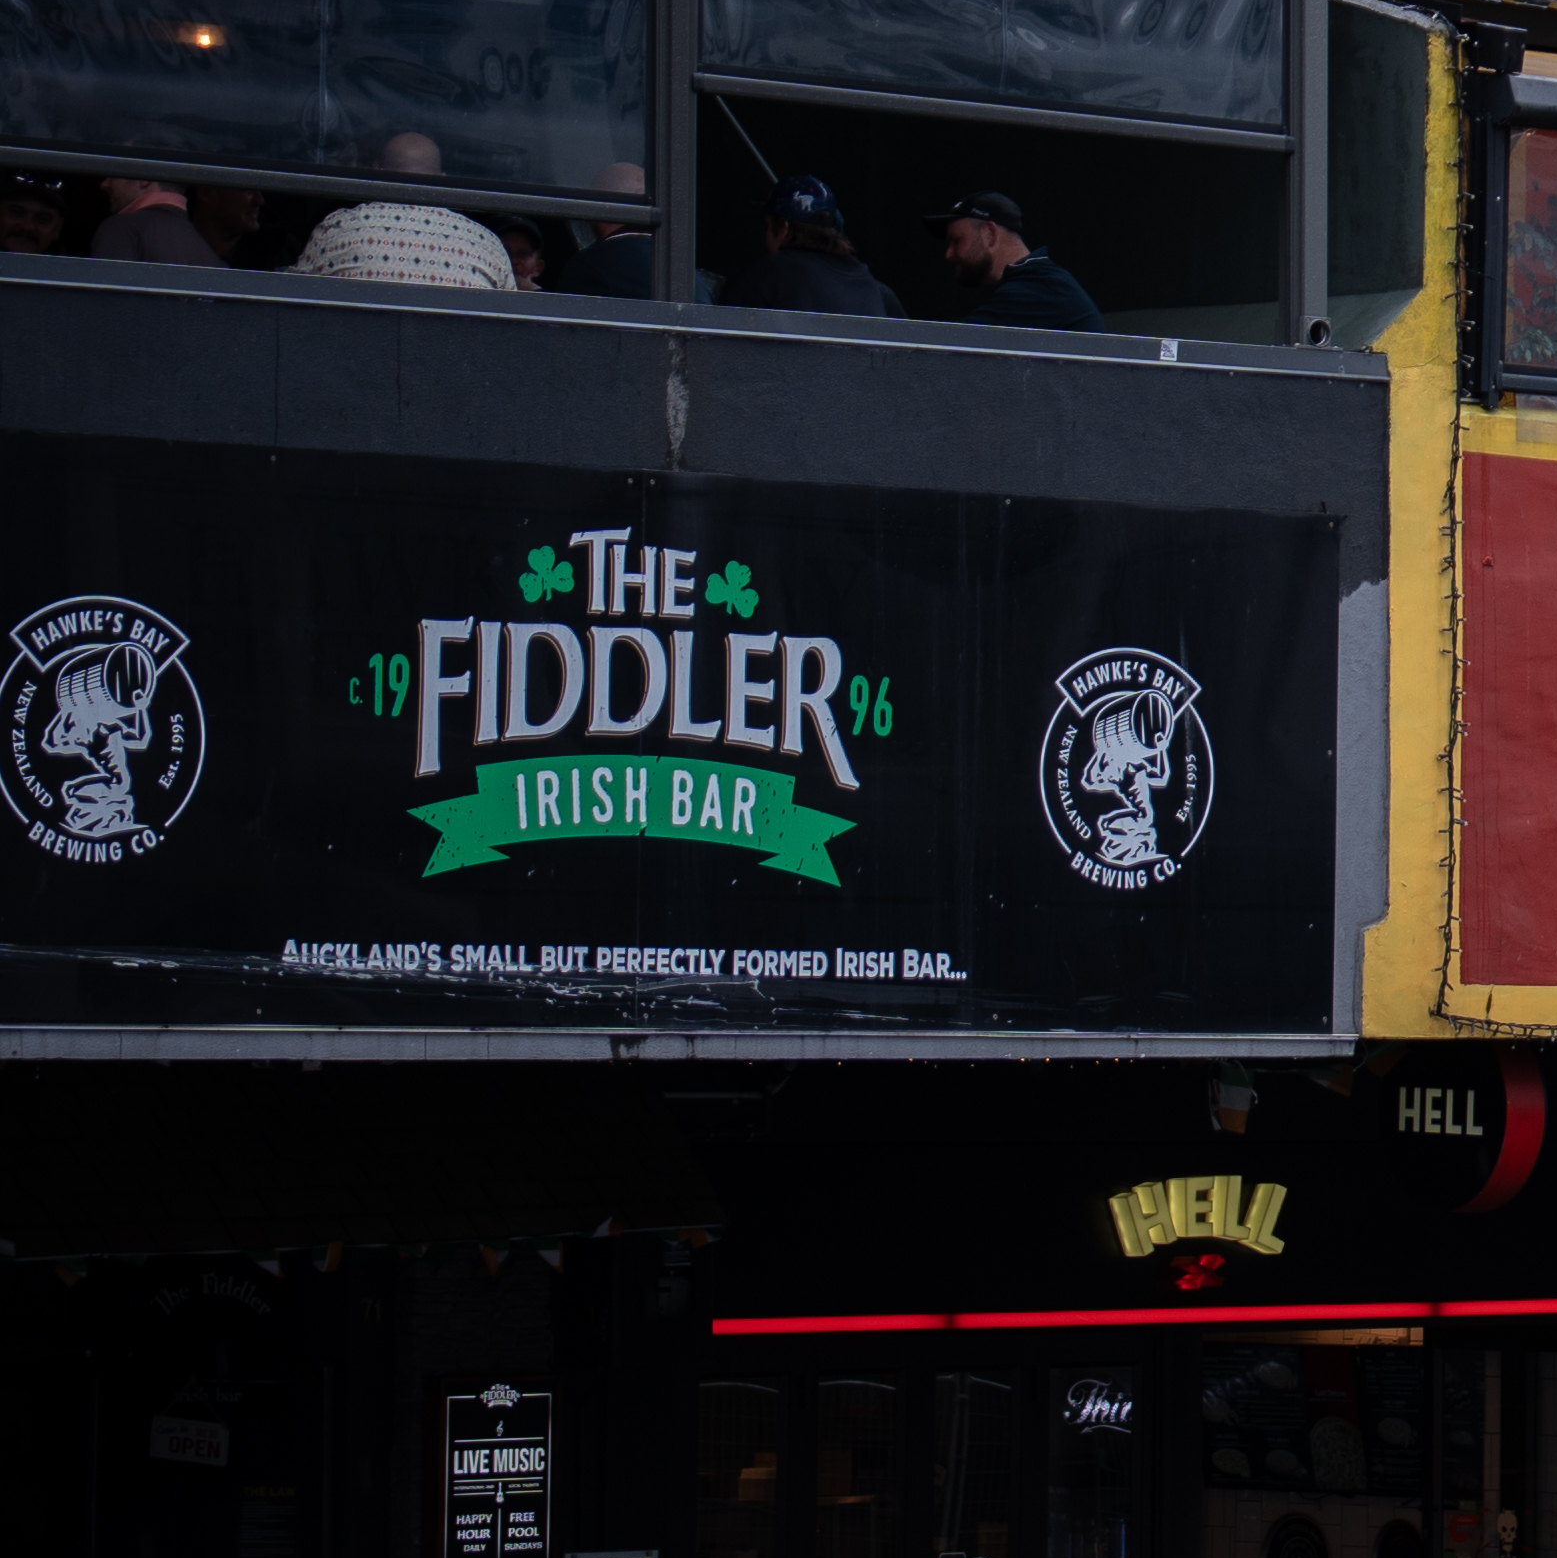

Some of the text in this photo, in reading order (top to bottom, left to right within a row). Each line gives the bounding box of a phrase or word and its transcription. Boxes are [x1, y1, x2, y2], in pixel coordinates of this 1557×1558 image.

[569, 526, 698, 619] THE
[30, 610, 171, 654] HAWKE'S BAY
[1071, 660, 1186, 701] HAWKE'S BAY
[414, 615, 861, 790] FIDDLER
[12, 679, 54, 809] NEW ZEALAND
[169, 712, 185, 753] 1995
[1057, 724, 1092, 839] NEW ZEALAND
[1185, 753, 1198, 790] 1995
[515, 765, 759, 836] IRISH BAR
[27, 820, 166, 863] BREWING CO.
[1070, 850, 1183, 889] BREWING CO.
[282, 938, 443, 972] AUCKLAND'S
[449, 943, 533, 973] SMALL
[540, 945, 590, 973] BUT
[595, 947, 725, 978] PERFECTLY
[731, 950, 829, 979] FORMED
[835, 946, 896, 980] IRISH
[1398, 1085, 1485, 1138] HELL
[1107, 1173, 1288, 1258] HELL
[167, 1435, 222, 1460] OPEN
[453, 1446, 546, 1476] LIVE MUSIC
[455, 1513, 493, 1526] HAPPY
[456, 1528, 492, 1541] HOUR
